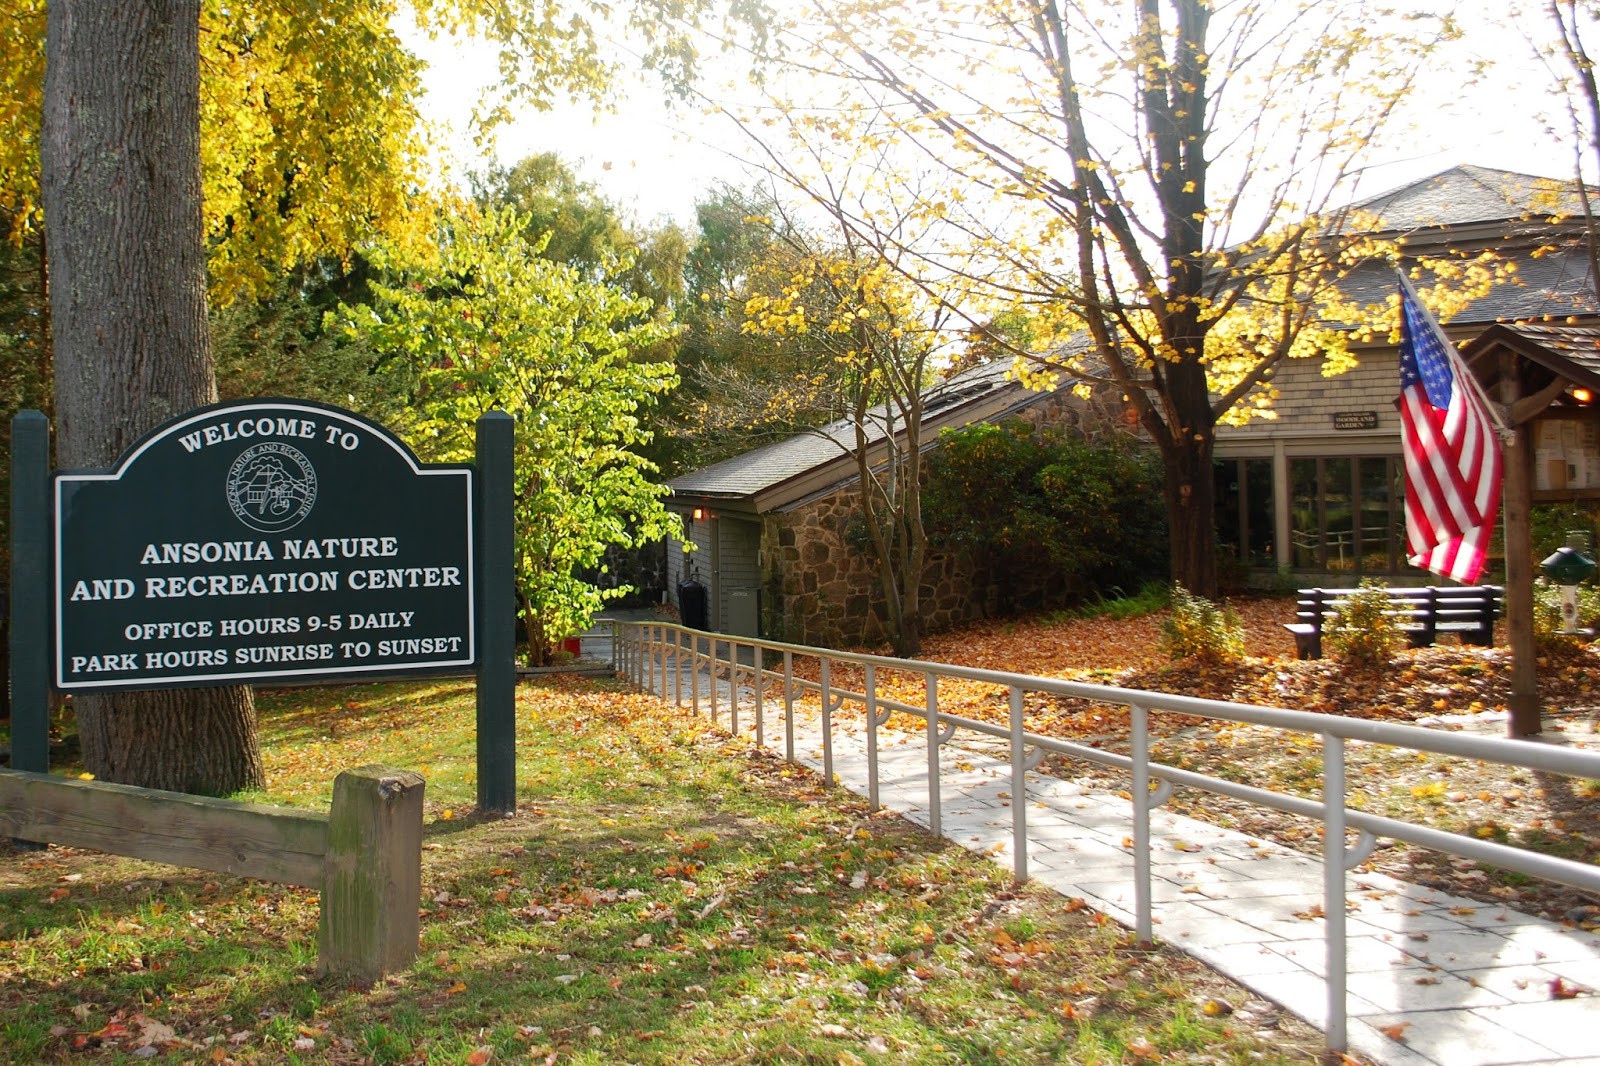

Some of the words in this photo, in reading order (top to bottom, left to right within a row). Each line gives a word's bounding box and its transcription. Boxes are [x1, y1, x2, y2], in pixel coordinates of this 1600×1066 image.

[178, 418, 316, 453] WELCOME
[326, 425, 360, 451] TO
[258, 444, 279, 453] AND
[231, 449, 256, 476] NATURE
[280, 445, 315, 485] RECREATION
[228, 480, 245, 516] ANSONIA
[298, 487, 316, 517] CENTER
[140, 541, 274, 565] ANSONIA
[283, 537, 398, 560] NATURE
[71, 579, 135, 602] AND
[145, 571, 338, 598] RECREATION
[348, 567, 461, 589] CENTER
[125, 619, 213, 641] OFFICE
[220, 616, 300, 636] HOURS
[308, 614, 342, 632] 9-5
[349, 612, 415, 630] DAILY
[72, 653, 138, 673] PARK
[146, 648, 229, 669] HOURS
[236, 643, 334, 664] SUNRISE
[340, 641, 371, 659] TO
[378, 637, 461, 656] SUNSET
